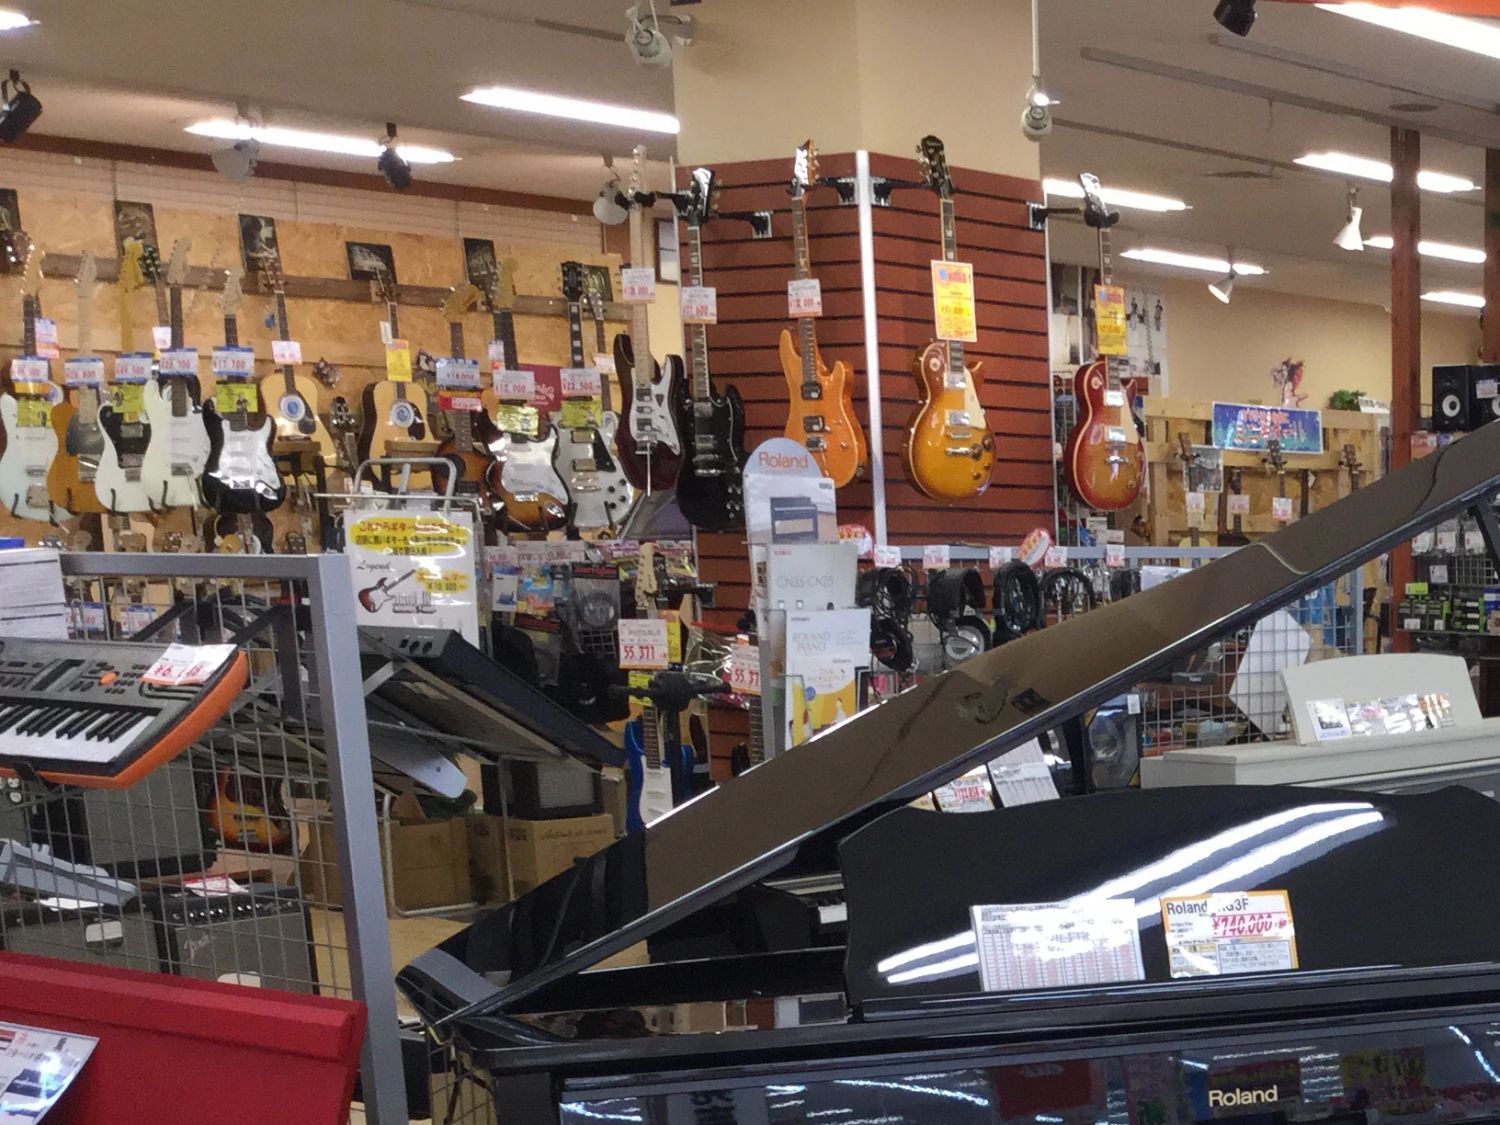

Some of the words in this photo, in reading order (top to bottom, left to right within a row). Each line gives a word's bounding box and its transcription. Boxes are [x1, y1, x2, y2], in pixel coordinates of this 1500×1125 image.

[758, 450, 809, 470] Roland
[1166, 899, 1209, 917] Roland
[1208, 1085, 1278, 1107] Roland
